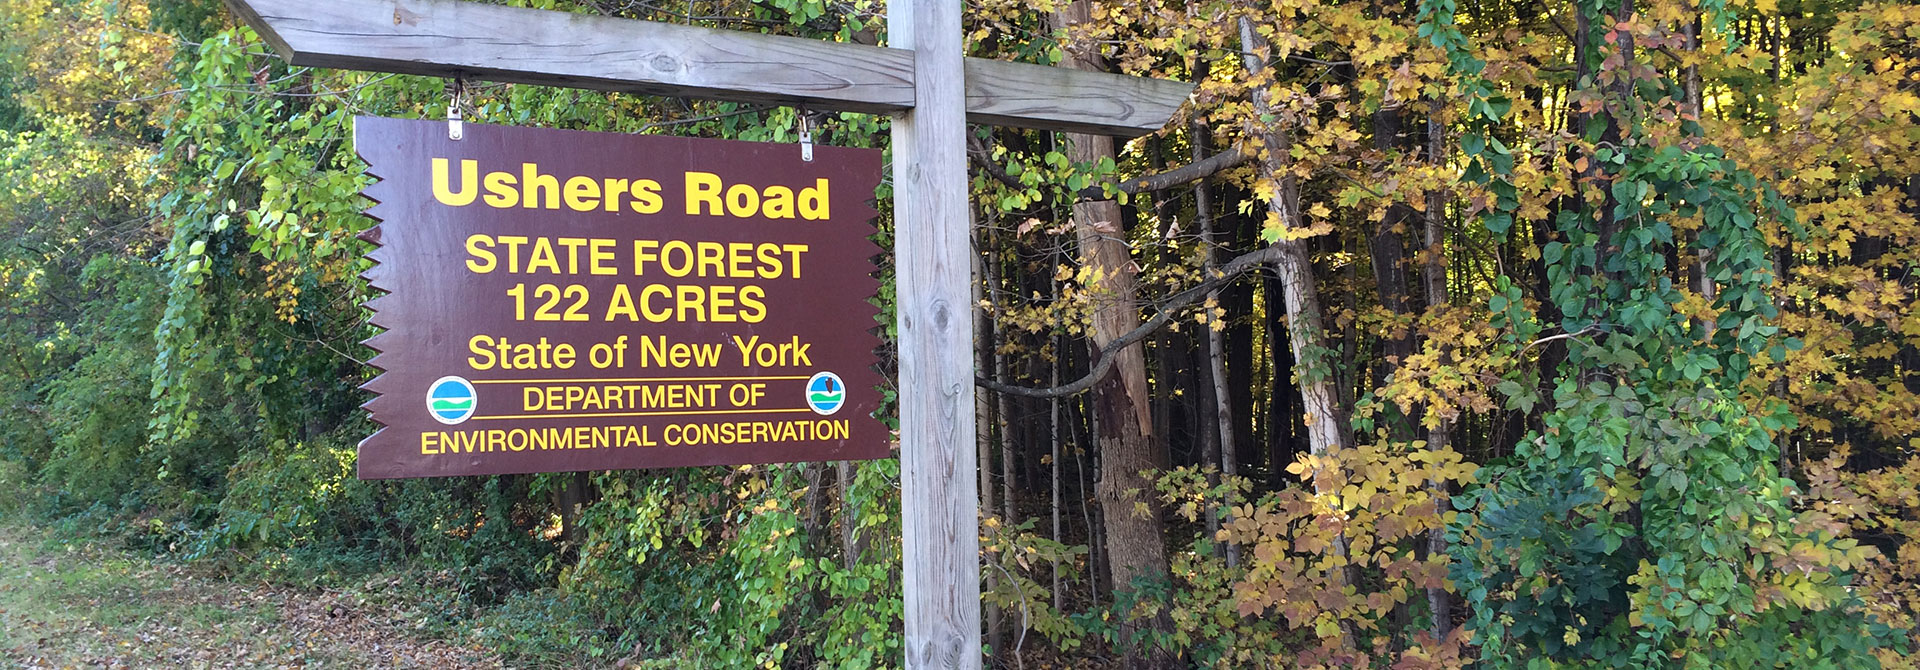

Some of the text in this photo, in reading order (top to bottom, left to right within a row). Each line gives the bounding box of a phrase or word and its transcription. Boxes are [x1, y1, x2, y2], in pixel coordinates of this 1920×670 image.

[431, 158, 830, 220] Ushers Road
[465, 234, 809, 279] STATE FOREST
[506, 283, 768, 323] 122 ACRES
[467, 335, 812, 371] State of New York
[522, 383, 766, 412] DEPARTMENT OF
[420, 419, 850, 455] ENVIRONMENTAL CONSERVATION
